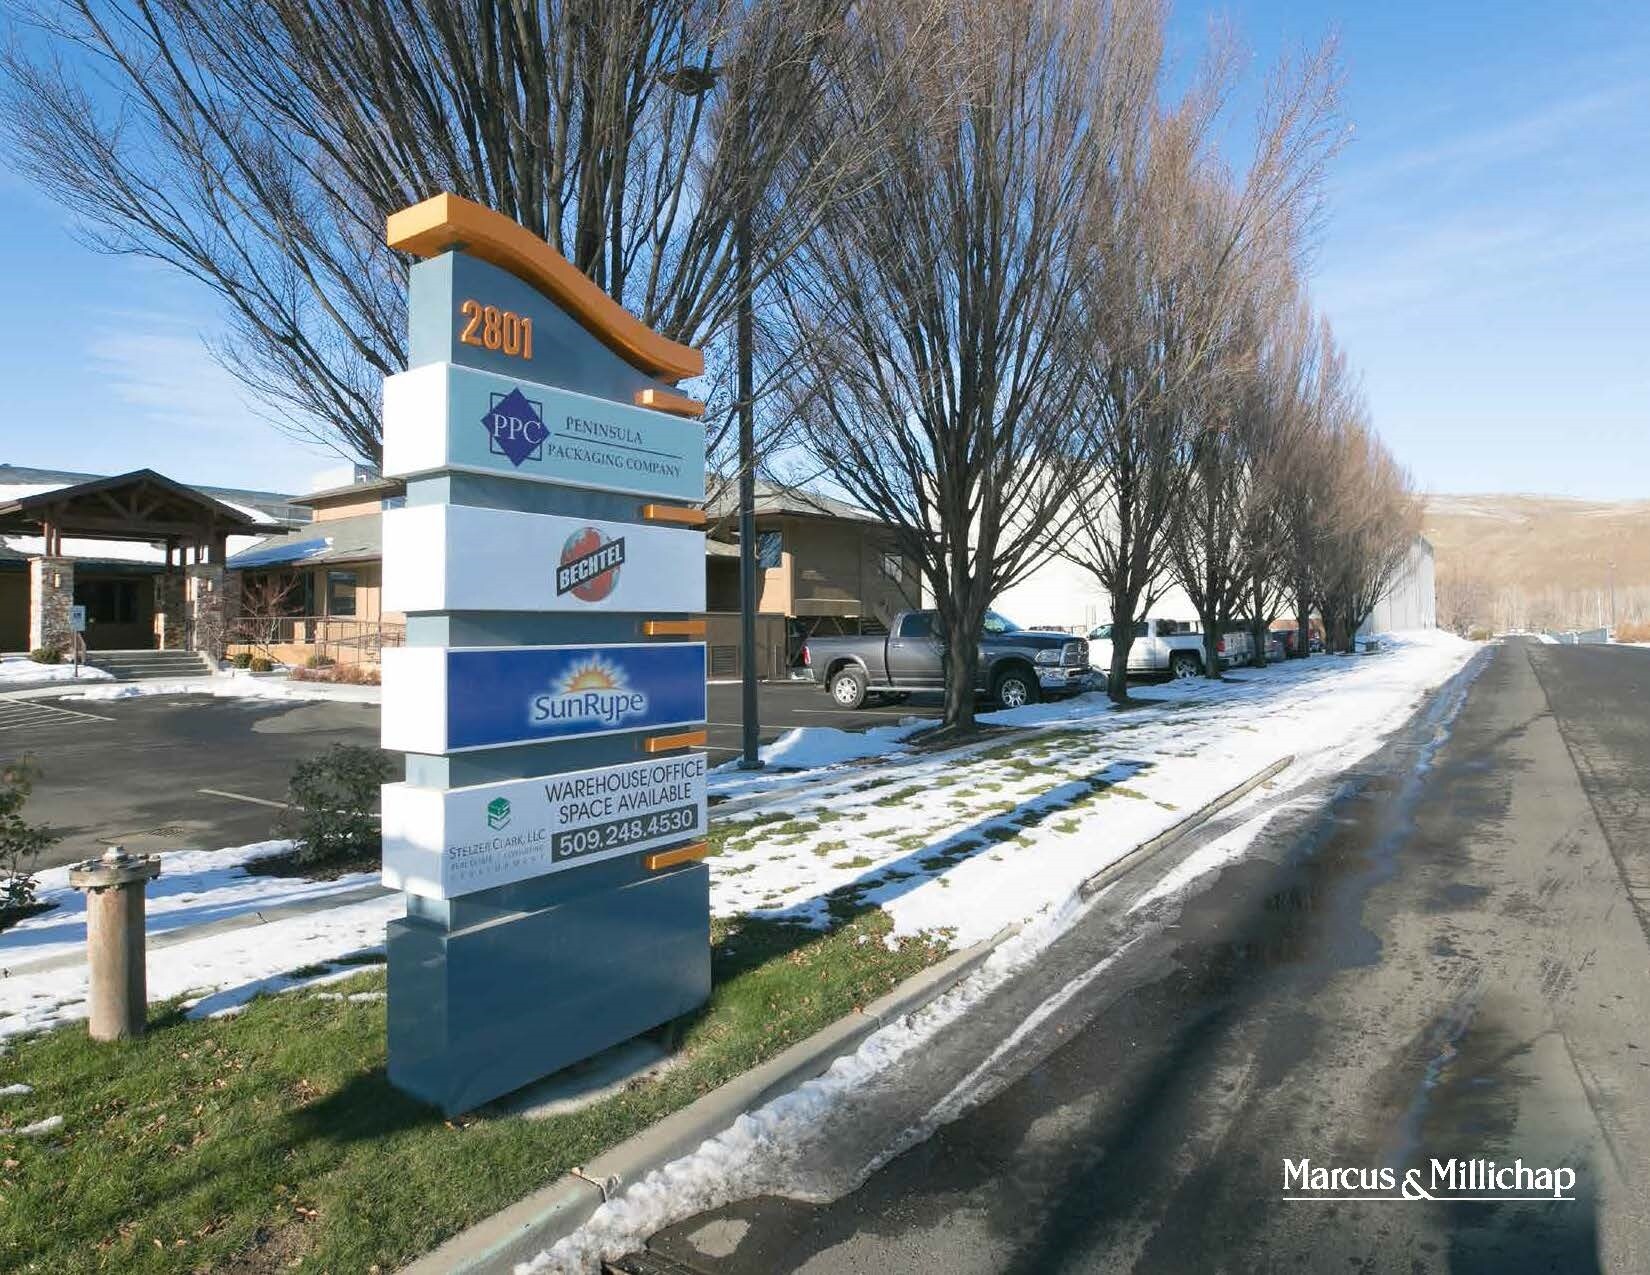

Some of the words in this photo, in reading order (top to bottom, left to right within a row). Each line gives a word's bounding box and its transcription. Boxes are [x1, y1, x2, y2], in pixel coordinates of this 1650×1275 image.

[461, 299, 533, 359] 2801
[493, 414, 543, 445] PPC
[566, 415, 643, 445] PENINSULA
[548, 445, 624, 469] PACKAGING
[626, 456, 682, 478] COMPANY
[559, 543, 623, 590] BECHTEL
[535, 693, 643, 721] SunRype
[545, 760, 704, 803] WAREHOUSE/OFFICE
[559, 798, 612, 824] SPACE
[618, 782, 691, 813] AVAILABLE
[559, 809, 693, 856] 509.248.4530
